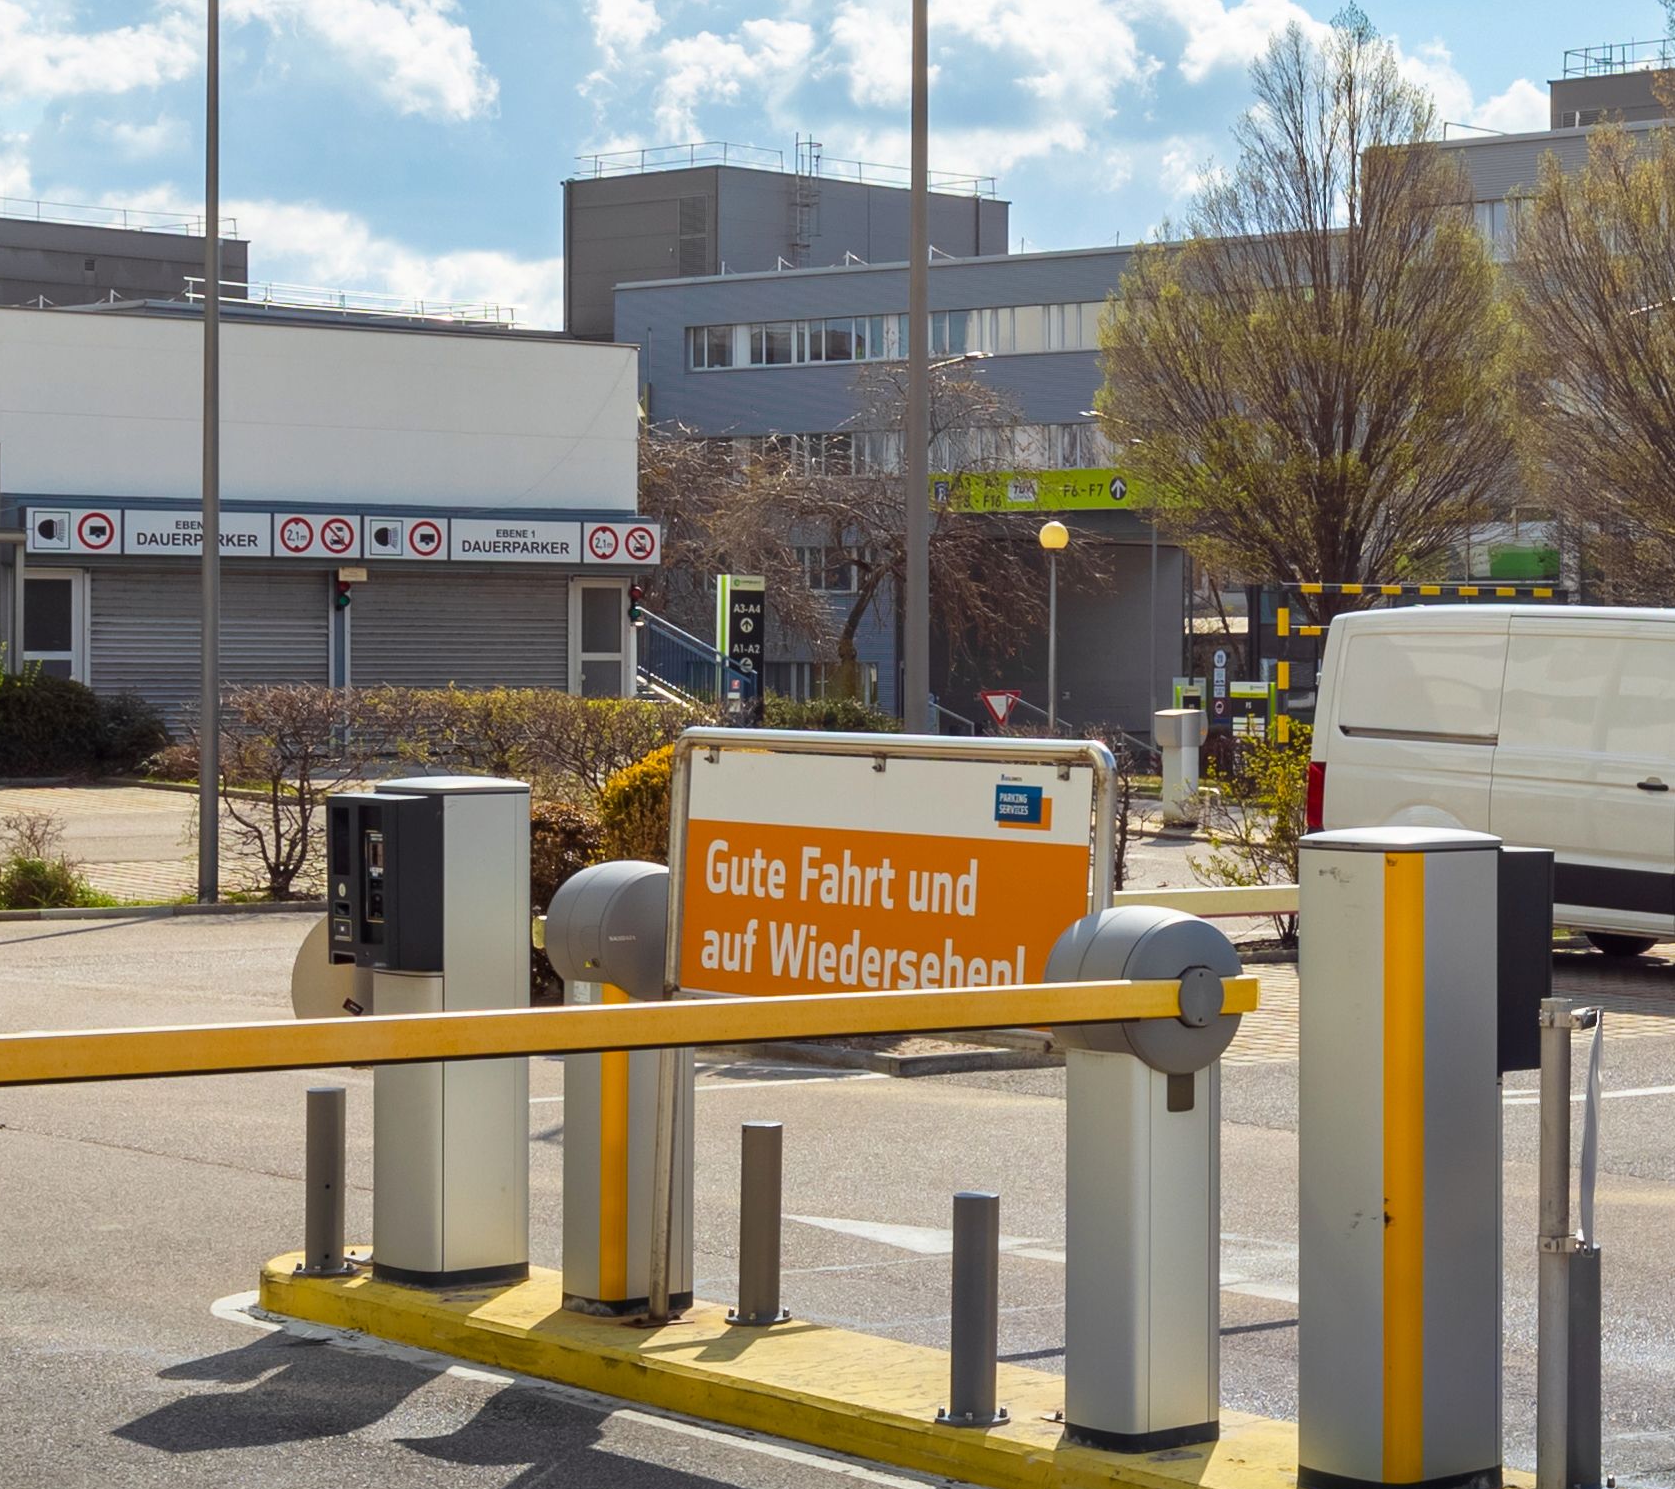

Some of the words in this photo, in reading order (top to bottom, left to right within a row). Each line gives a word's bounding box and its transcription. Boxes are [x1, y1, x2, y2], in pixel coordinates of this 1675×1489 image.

[175, 520, 204, 530] EBEN
[136, 532, 259, 548] DAUERPRKER
[496, 528, 529, 539] EBENE
[531, 529, 536, 539] 1
[461, 540, 570, 555] DAUERPARKER
[999, 792, 1028, 804] PARKING
[999, 804, 1029, 815] SERVICES
[706, 839, 786, 899] Gute
[800, 846, 896, 909] Fahrt
[908, 858, 978, 917] und
[701, 918, 758, 973] auf
